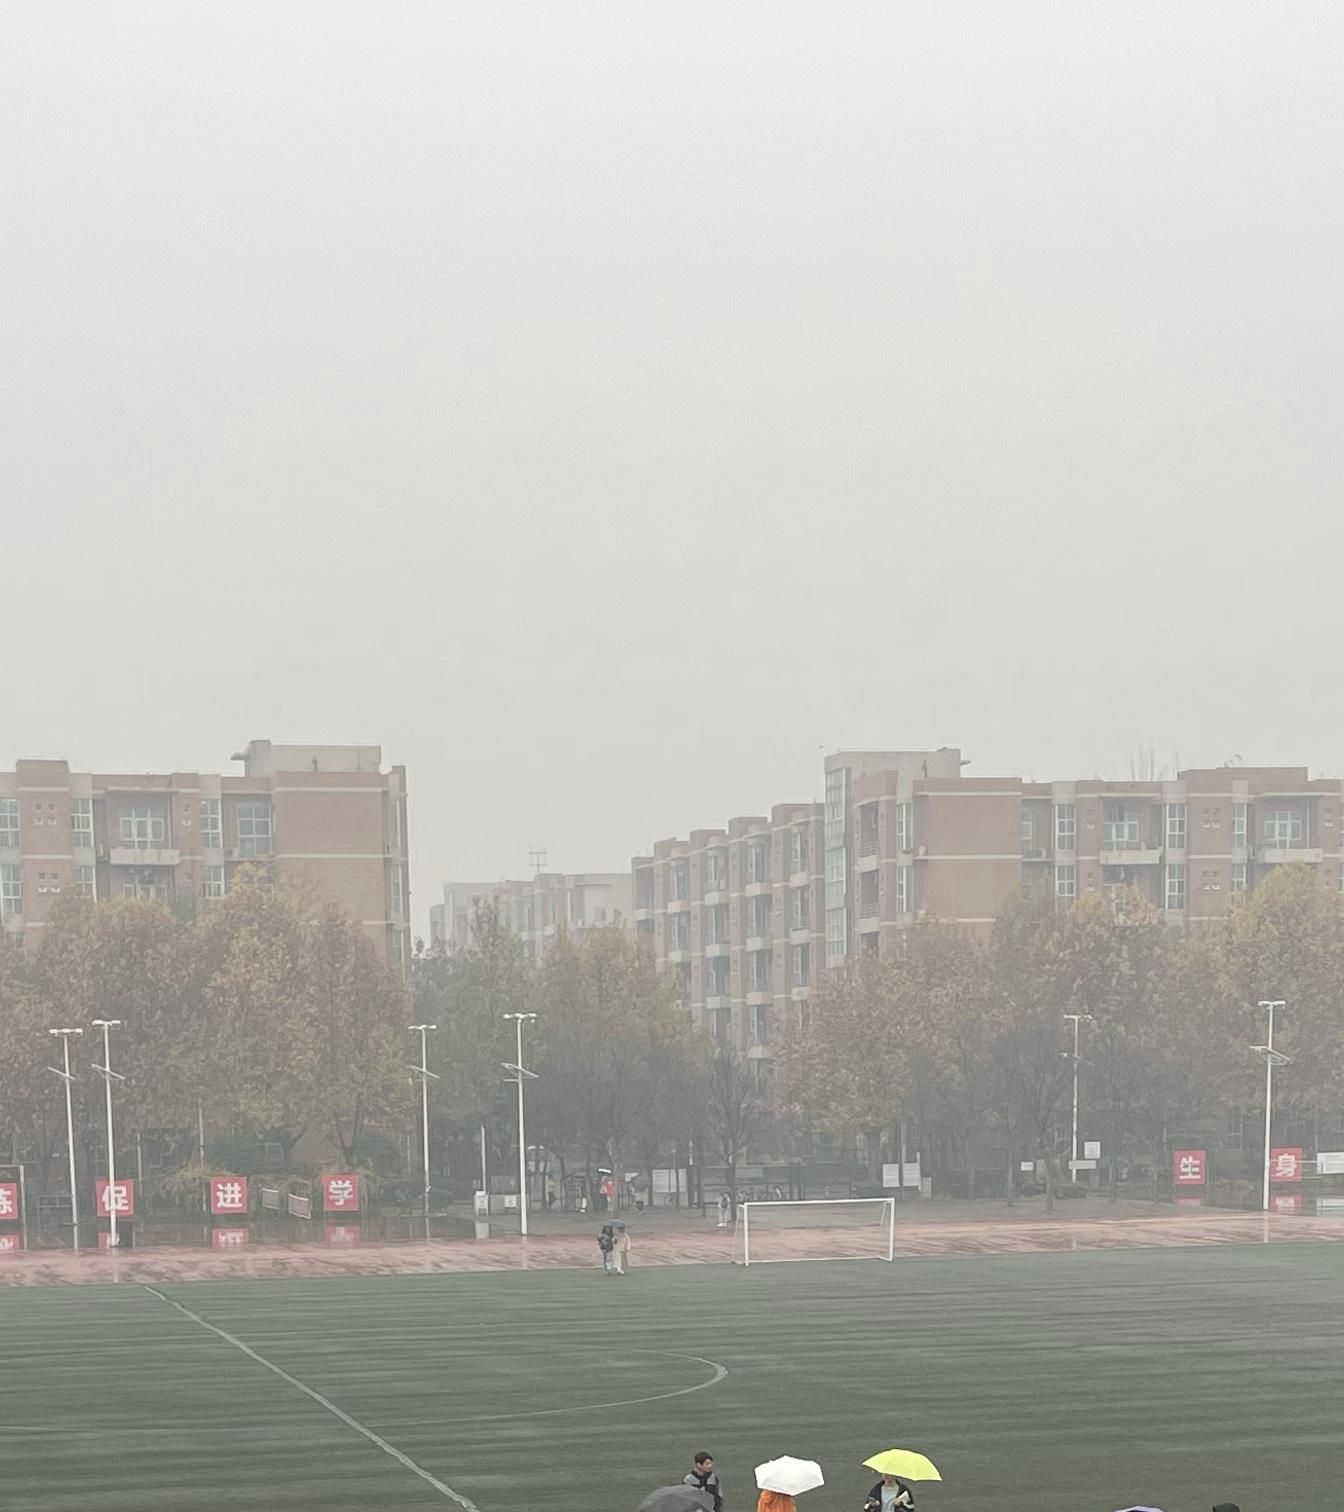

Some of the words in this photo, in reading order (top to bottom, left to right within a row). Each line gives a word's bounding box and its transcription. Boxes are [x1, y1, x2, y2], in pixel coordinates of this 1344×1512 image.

[1179, 1157, 1201, 1179] 生
[1274, 1152, 1298, 1178] 身
[216, 1182, 243, 1209] 进
[328, 1179, 354, 1206] 学
